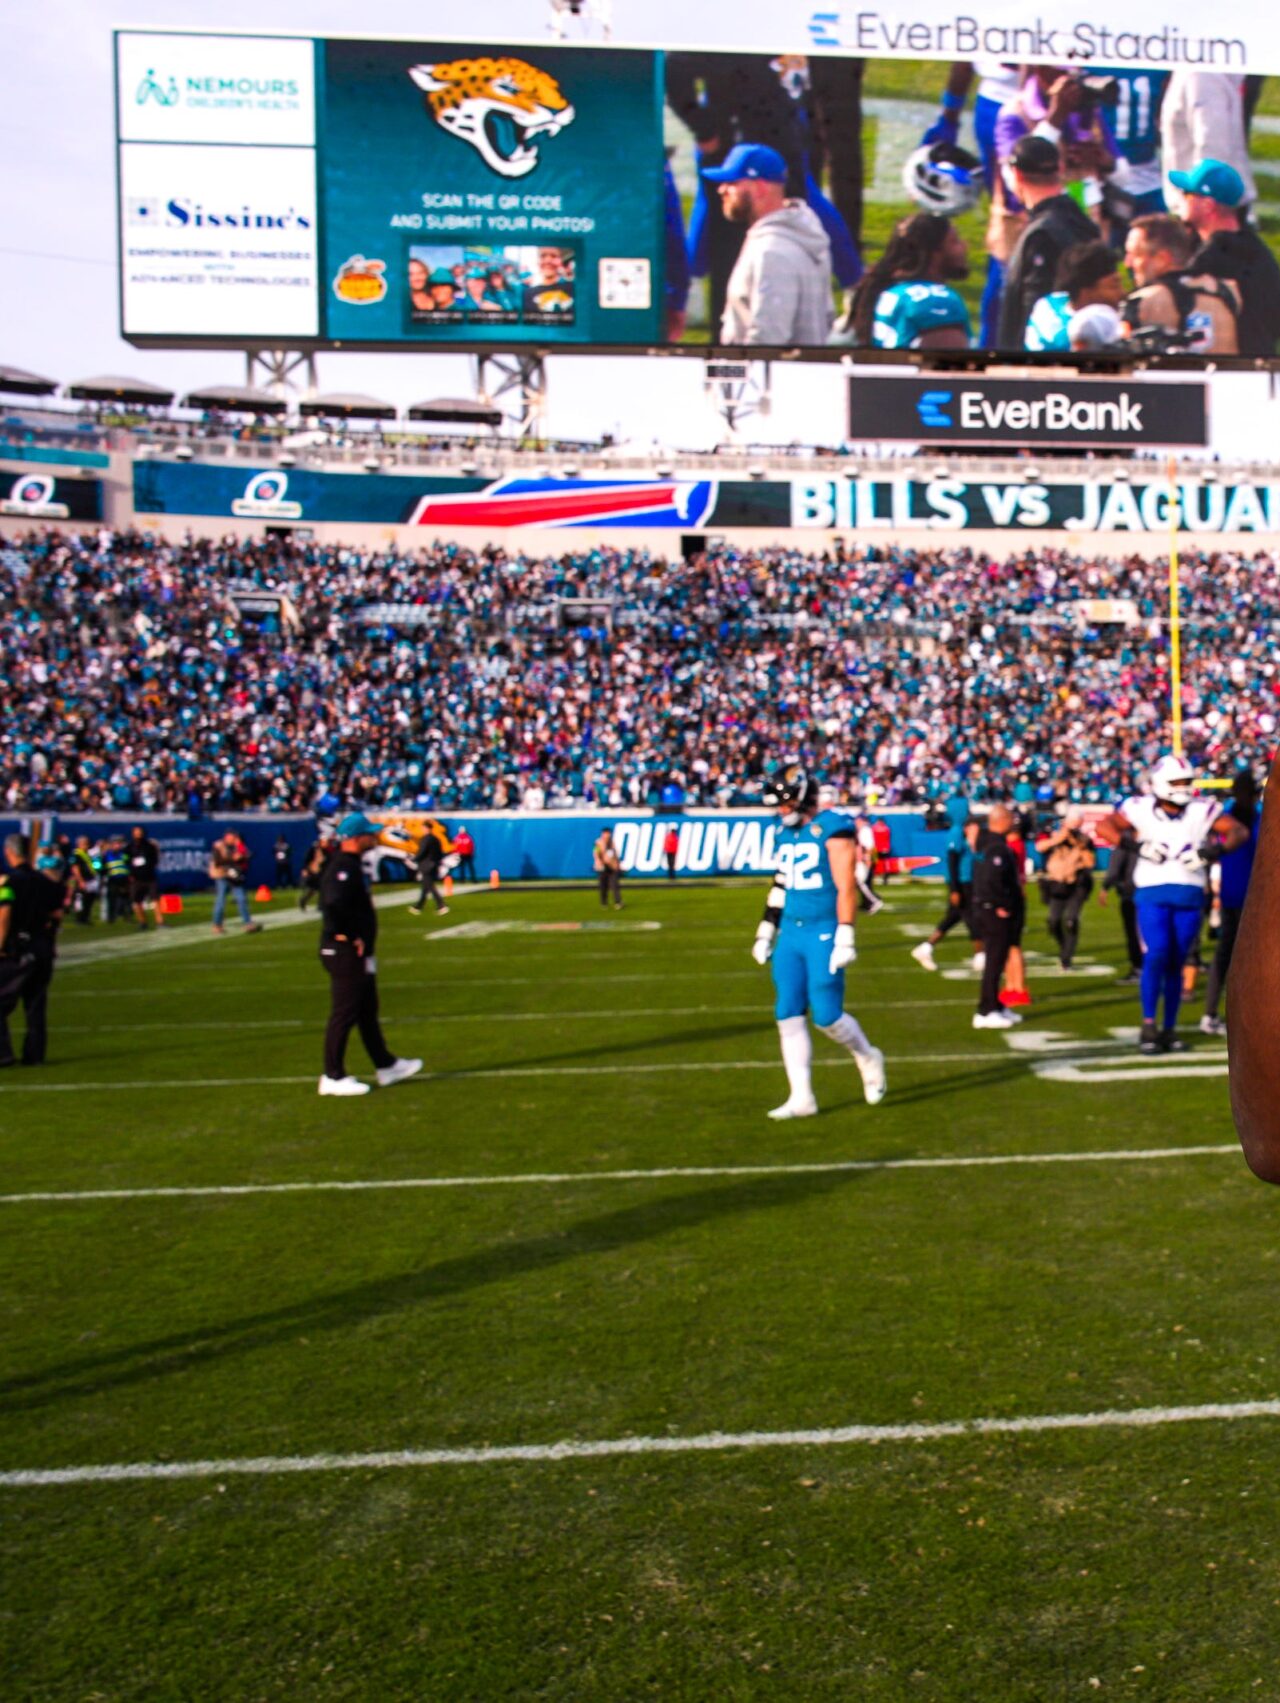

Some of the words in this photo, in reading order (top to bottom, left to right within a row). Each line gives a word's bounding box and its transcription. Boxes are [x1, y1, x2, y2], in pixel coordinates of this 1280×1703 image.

[856, 12, 1058, 57] EverBank
[1072, 22, 1246, 65] Stadium
[186, 77, 299, 96] NEMOURS
[422, 193, 463, 209] SCAN
[467, 194, 494, 210] THE
[498, 195, 520, 210] QR
[523, 195, 562, 211] CODE
[390, 214, 422, 229] AND
[426, 214, 483, 230] SUBMIT
[487, 215, 528, 231] YOUR
[532, 216, 595, 233] PHOTOS!
[960, 392, 1143, 431] EverBank
[789, 480, 968, 530] BILLS
[777, 842, 824, 890] 92
